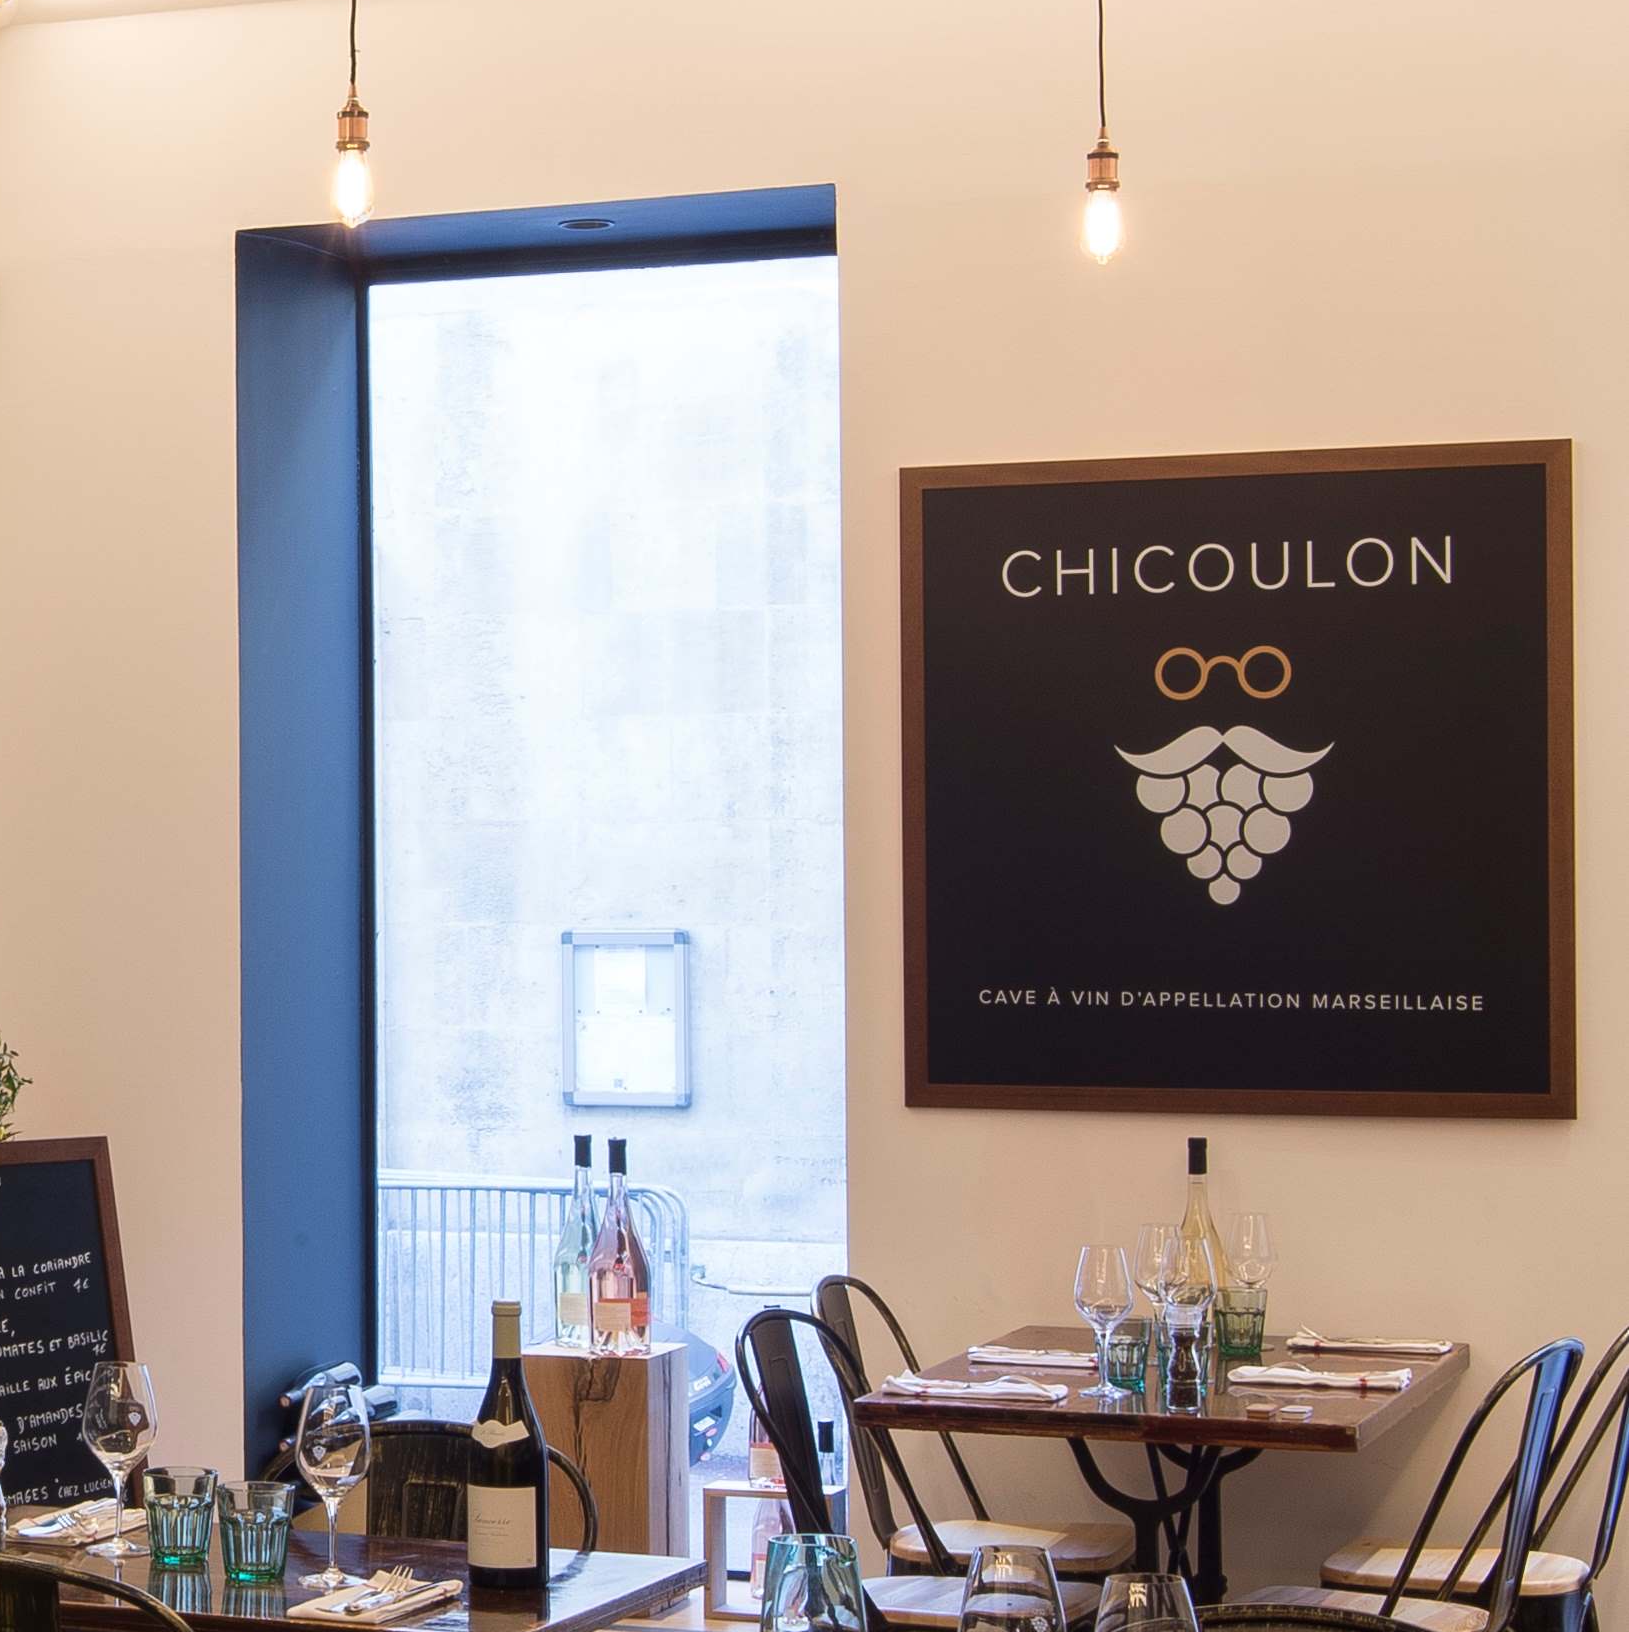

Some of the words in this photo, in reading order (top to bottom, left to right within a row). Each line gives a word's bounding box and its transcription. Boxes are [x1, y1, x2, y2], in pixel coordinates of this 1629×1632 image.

[1002, 535, 1454, 598] CHICOULON
[980, 989, 1037, 1005] CAVE
[1048, 986, 1061, 1006] À
[1071, 989, 1110, 1006] VIN
[1121, 990, 1301, 1009] D'APPELLATION
[1313, 992, 1484, 1011] MARSEILLAISE
[11, 1264, 26, 1278] LA
[37, 1374, 58, 1390] AUX
